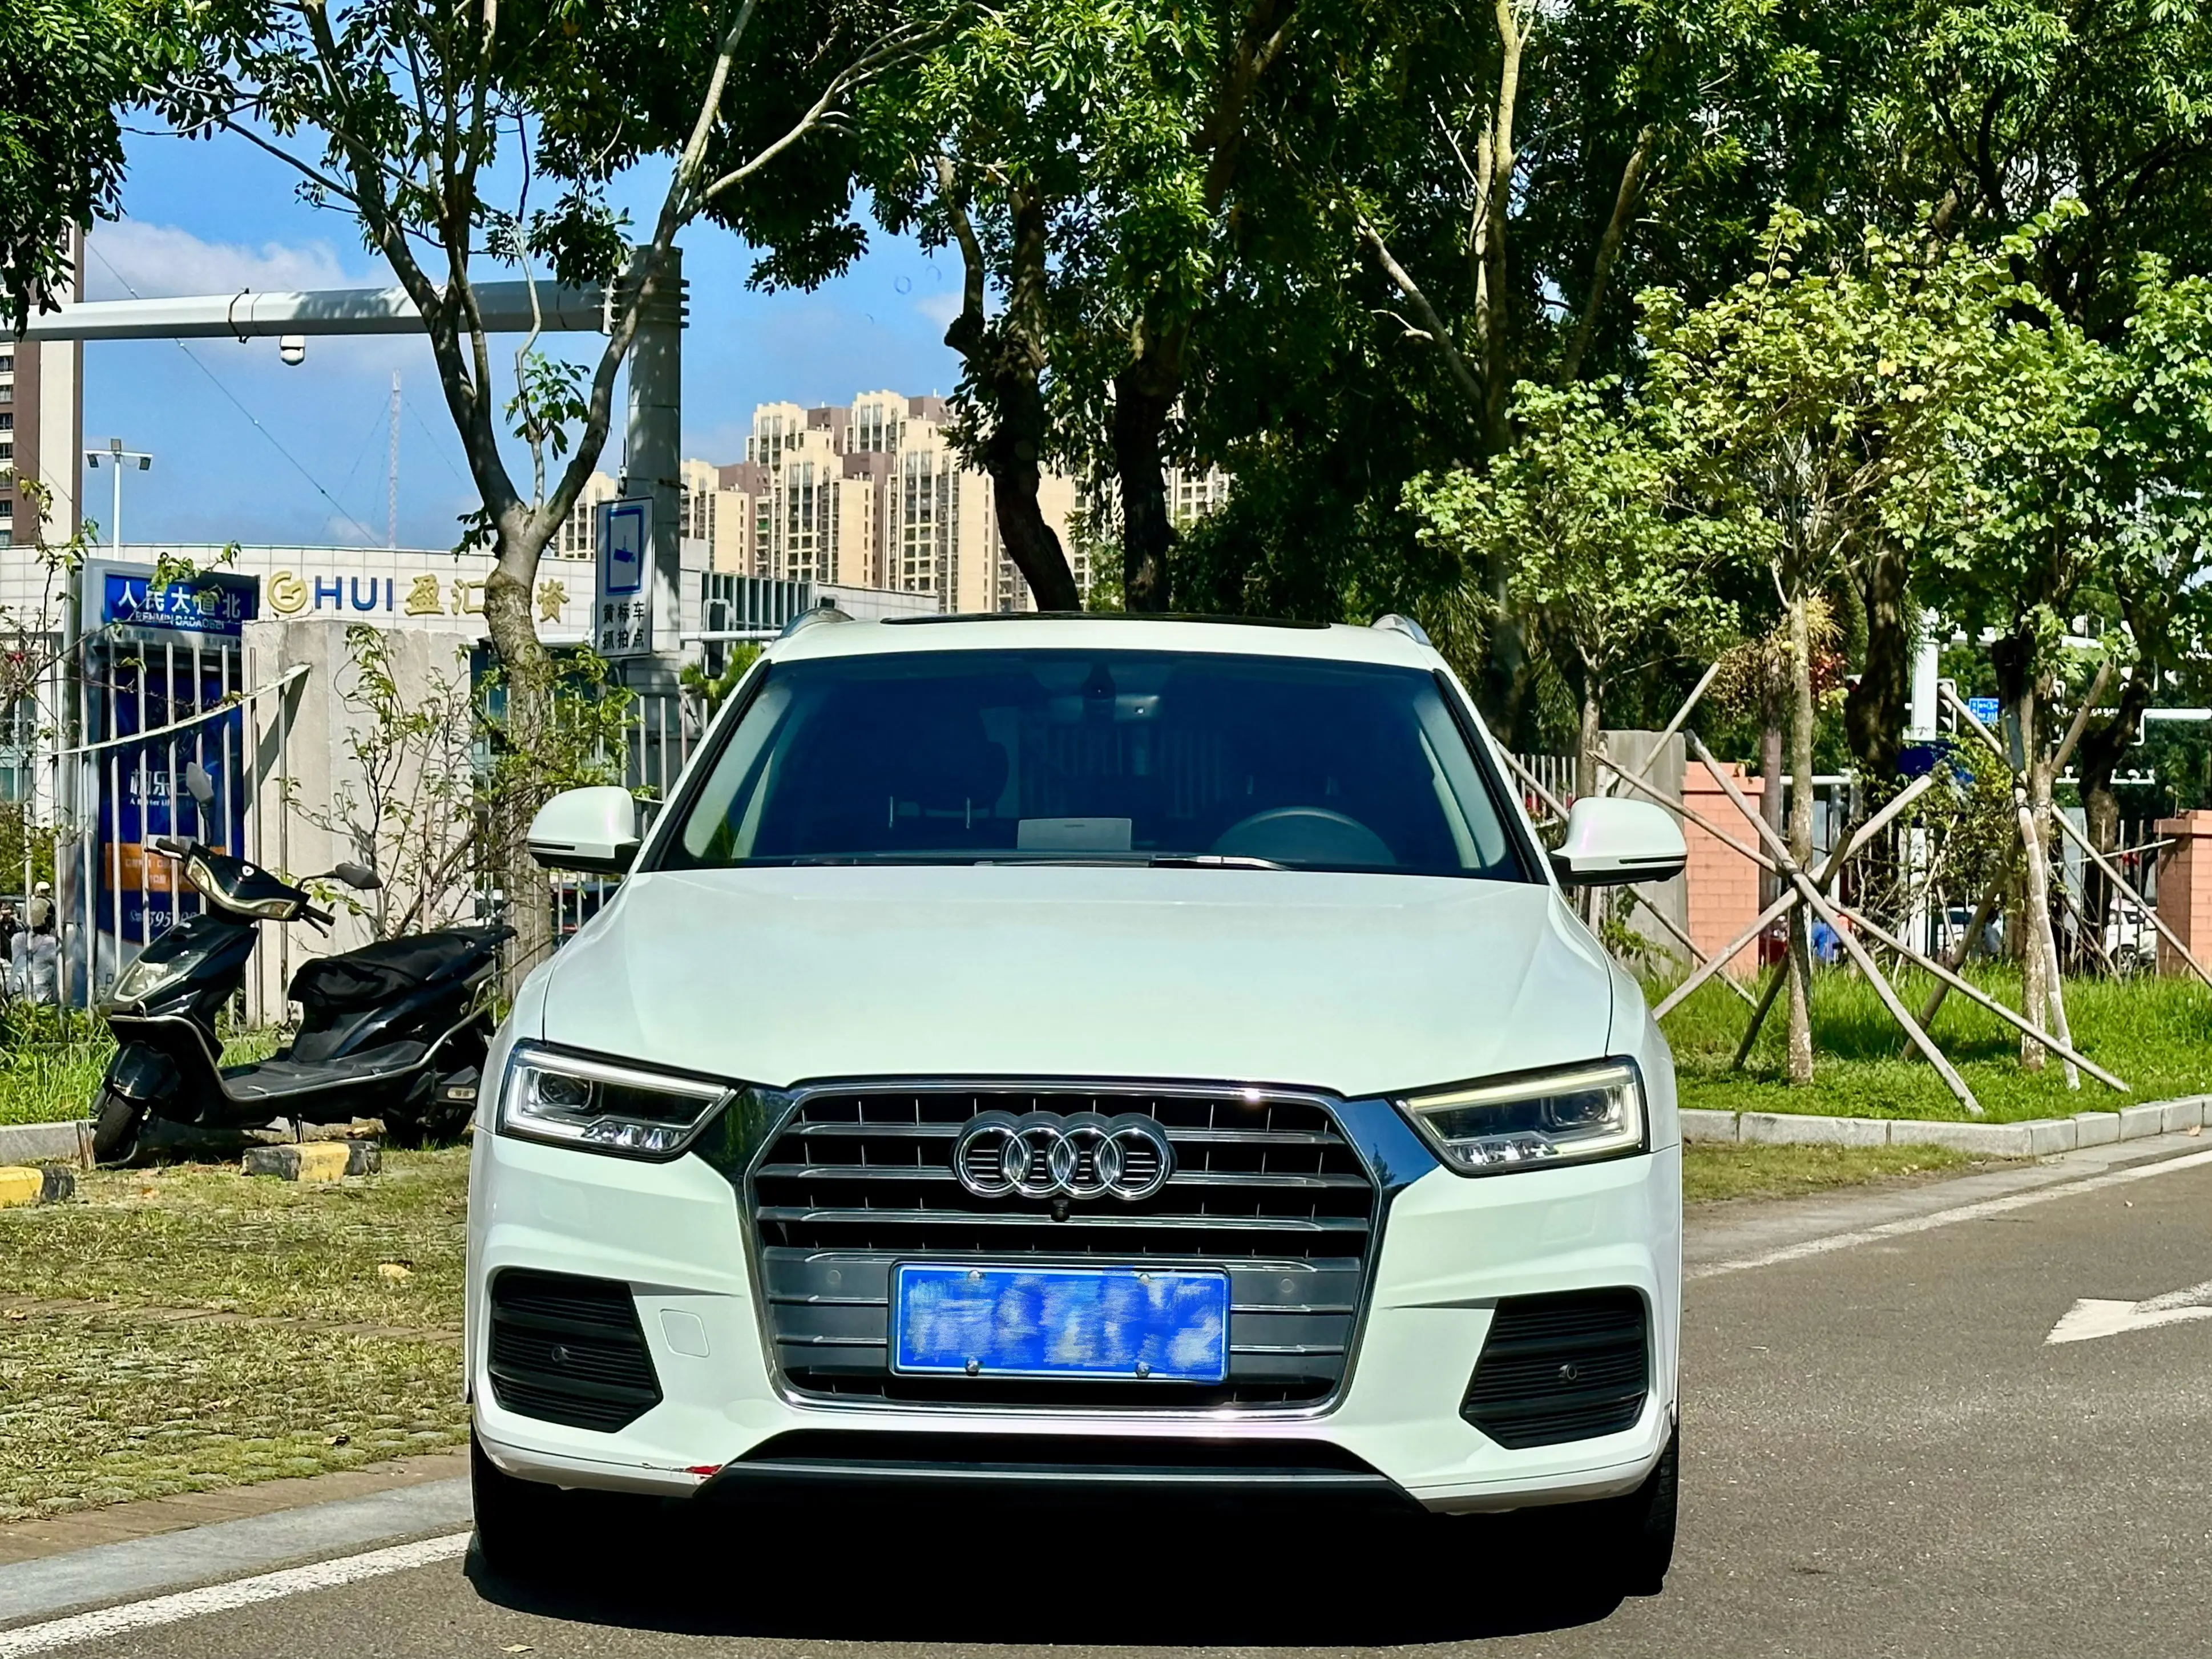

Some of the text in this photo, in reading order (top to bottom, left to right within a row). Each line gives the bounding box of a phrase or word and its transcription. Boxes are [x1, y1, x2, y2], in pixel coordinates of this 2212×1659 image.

[403, 574, 570, 624] 盈汇资
[603, 601, 645, 624] 黄标车
[603, 627, 644, 649] 抓拍点
